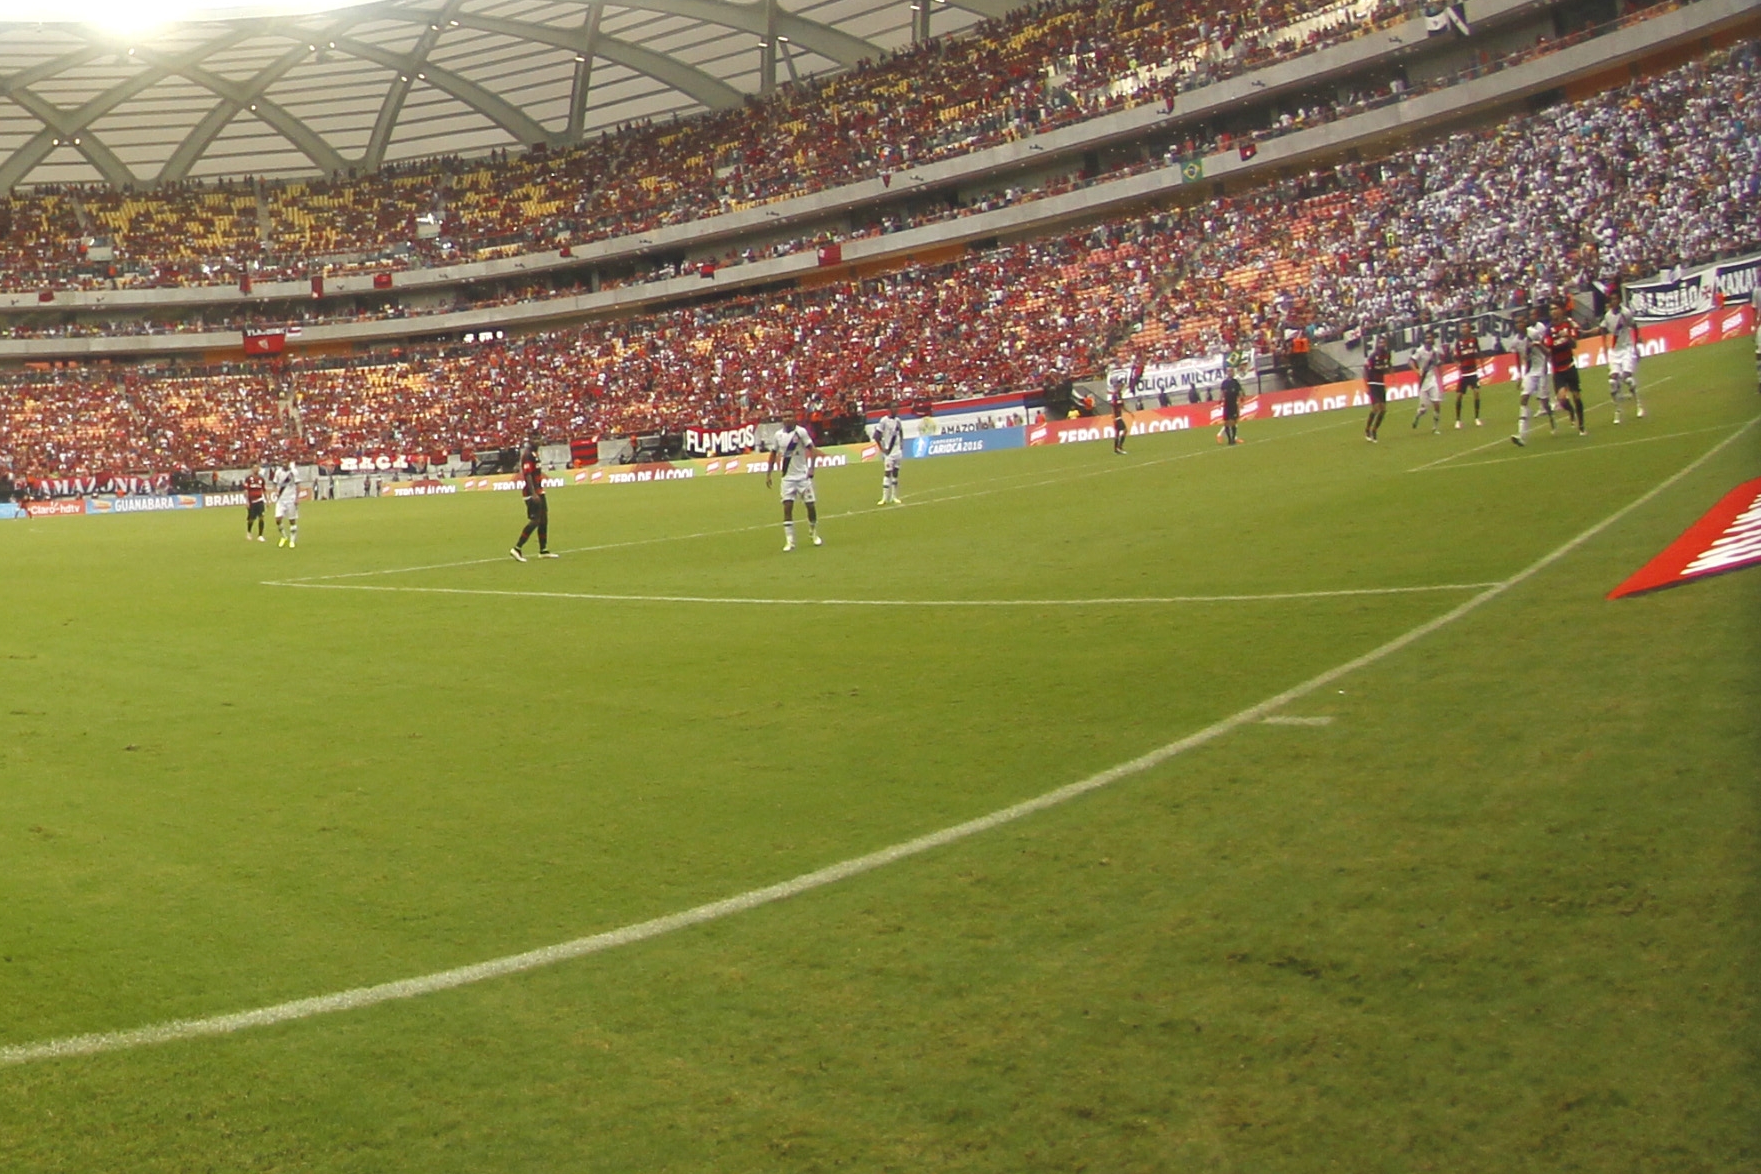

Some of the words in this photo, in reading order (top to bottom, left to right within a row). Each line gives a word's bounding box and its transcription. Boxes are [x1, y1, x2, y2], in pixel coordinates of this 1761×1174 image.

[1136, 375, 1177, 392] OLÍCIA
[686, 425, 755, 453] FLAMIGOS
[928, 443, 963, 455] CARIOCA
[963, 440, 983, 452] 2016
[115, 497, 174, 511] GUANABARA
[205, 494, 247, 506] BRAHM
